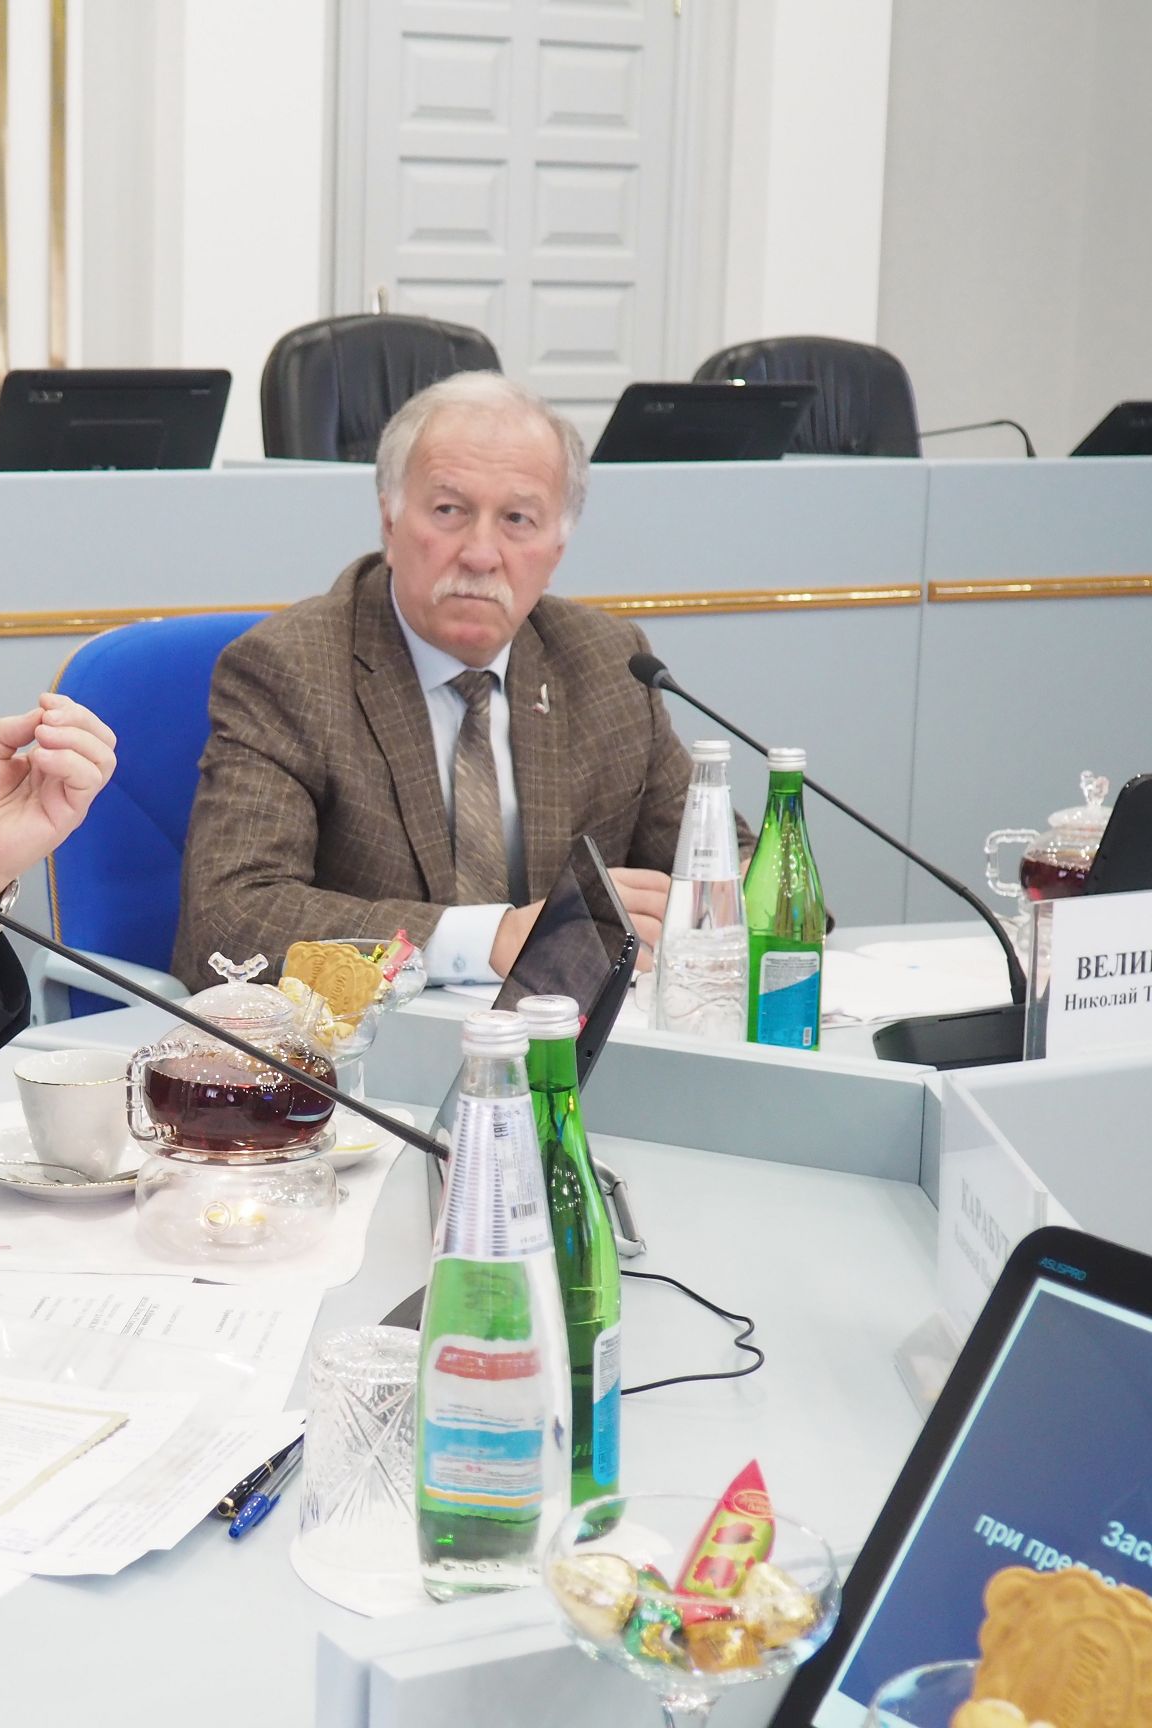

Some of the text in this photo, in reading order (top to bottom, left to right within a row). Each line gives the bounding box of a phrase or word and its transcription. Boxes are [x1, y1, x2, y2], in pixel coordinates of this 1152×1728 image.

[1076, 950, 1152, 980] ВЕЛИ
[1064, 987, 1137, 1011] Николай
[1039, 1257, 1087, 1281] ASUSPRO
[974, 1513, 1025, 1552] при
